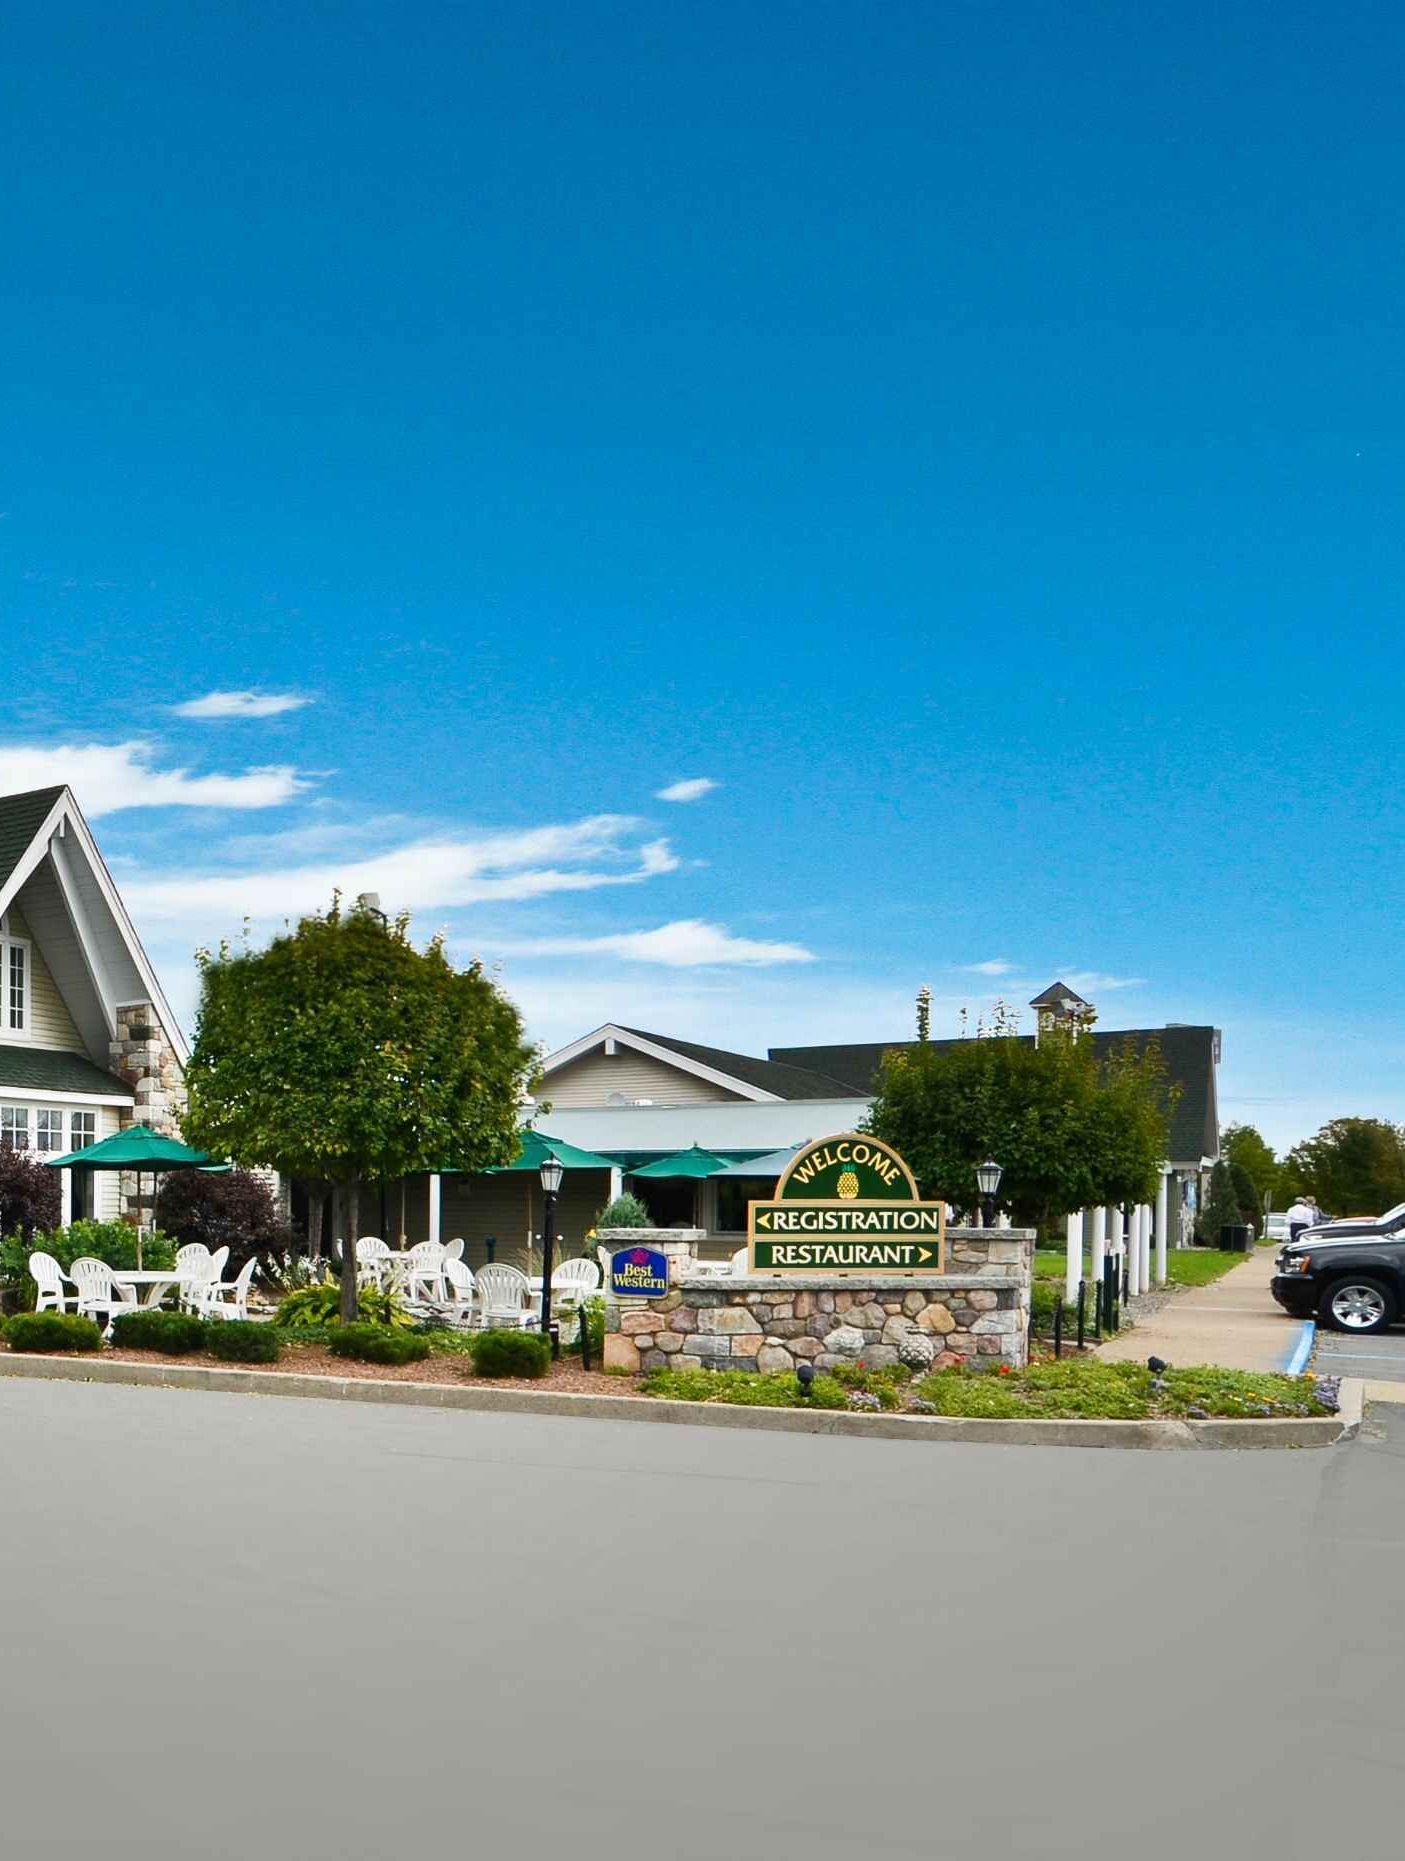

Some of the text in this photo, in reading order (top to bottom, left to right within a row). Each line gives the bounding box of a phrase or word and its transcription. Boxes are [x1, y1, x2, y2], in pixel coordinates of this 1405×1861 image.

[793, 1142, 901, 1187] WELCOME
[773, 1211, 938, 1230] REGISTRATION
[771, 1245, 916, 1264] RESTAURANT
[624, 1263, 653, 1276] Best
[613, 1273, 665, 1288] Western
